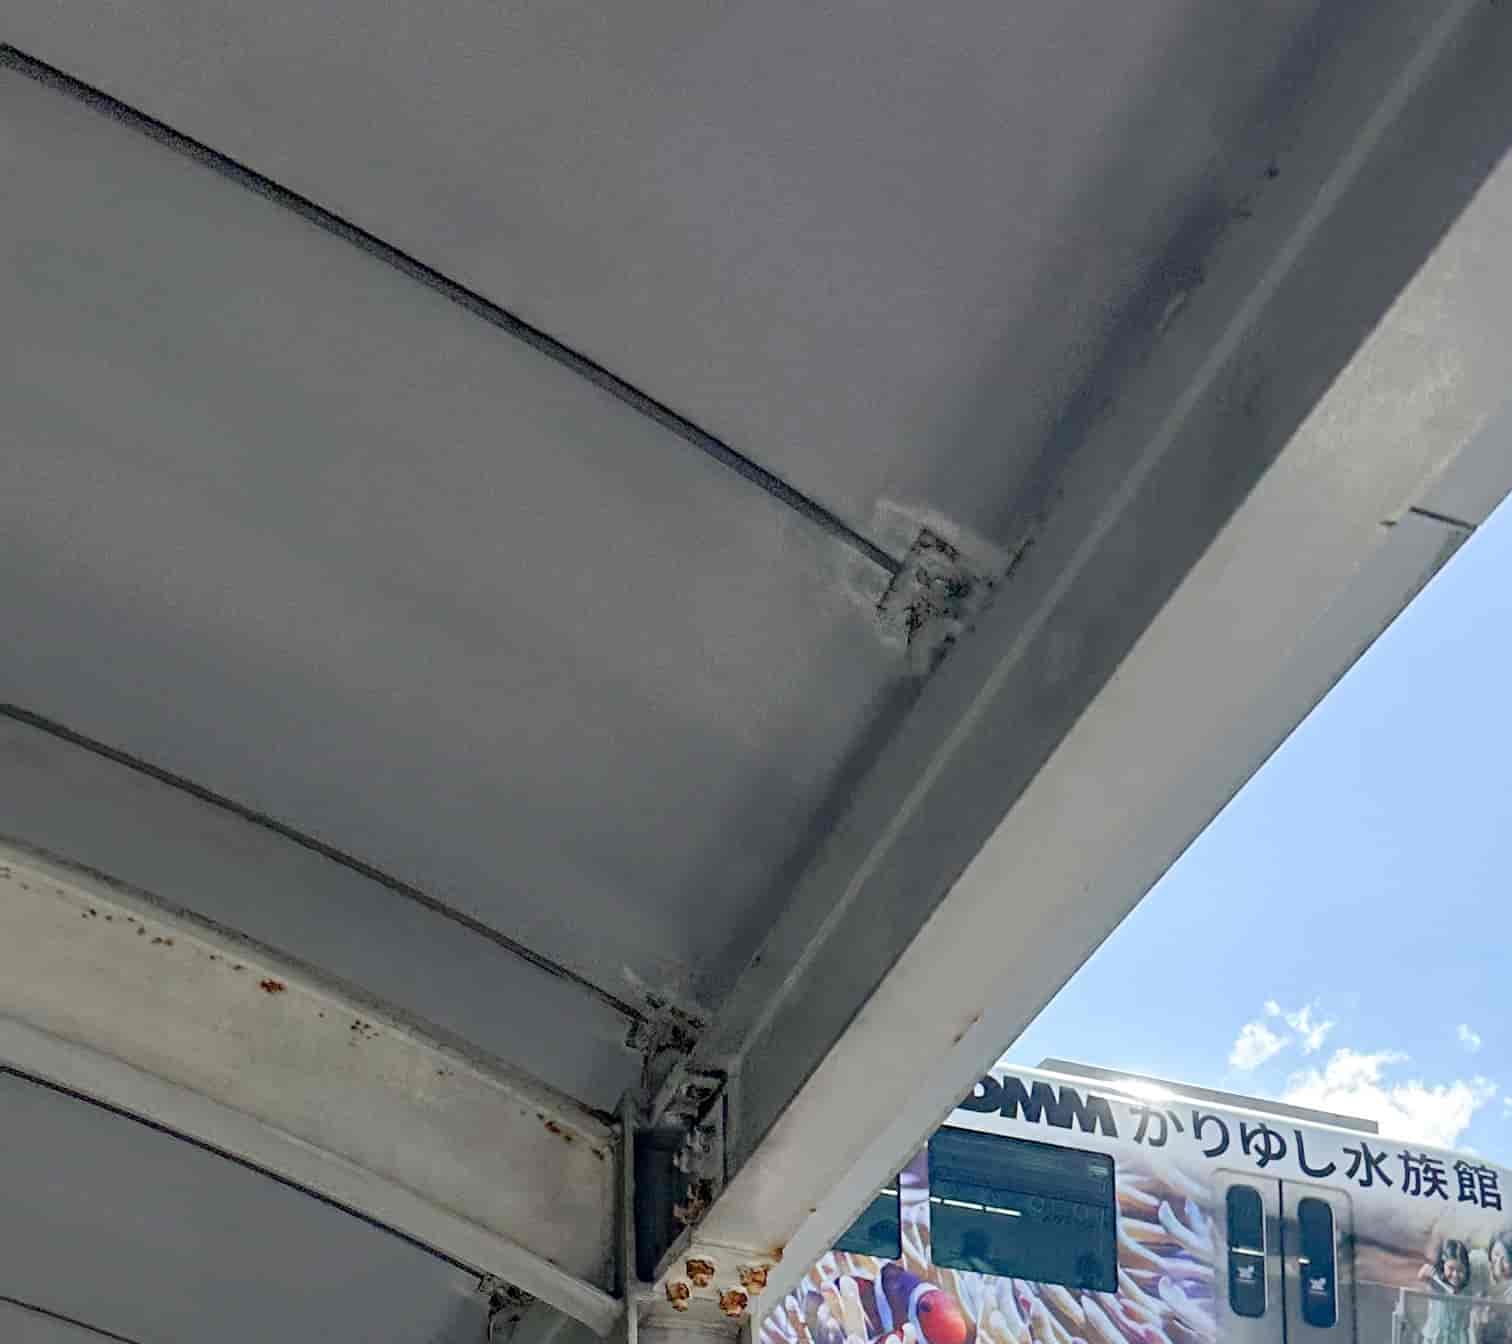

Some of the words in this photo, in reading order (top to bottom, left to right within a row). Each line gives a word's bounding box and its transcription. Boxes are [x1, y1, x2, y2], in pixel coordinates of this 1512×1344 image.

[1129, 1104, 1503, 1212] かりゆし水族館
